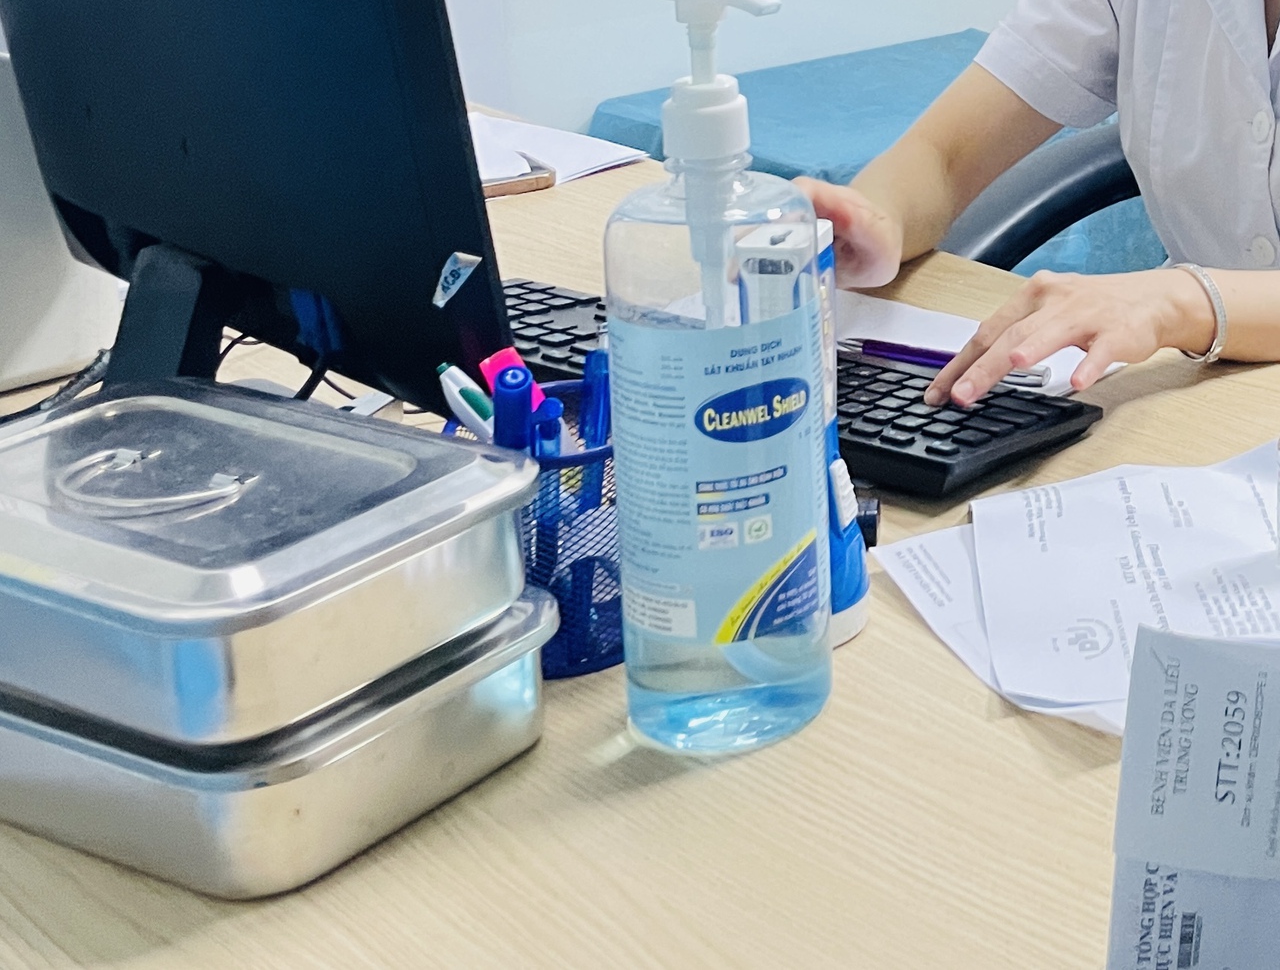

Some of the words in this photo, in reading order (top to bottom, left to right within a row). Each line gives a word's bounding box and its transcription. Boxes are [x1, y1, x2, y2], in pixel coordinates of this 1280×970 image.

[761, 355, 775, 366] TAY
[1161, 700, 1176, 723] DA
[1173, 737, 1192, 795] TRUNG
[1214, 690, 1247, 805] STT:2059
[1141, 877, 1162, 914] HỢP
[1156, 899, 1179, 940] HIỆN
[1133, 916, 1155, 965] TỔNG
